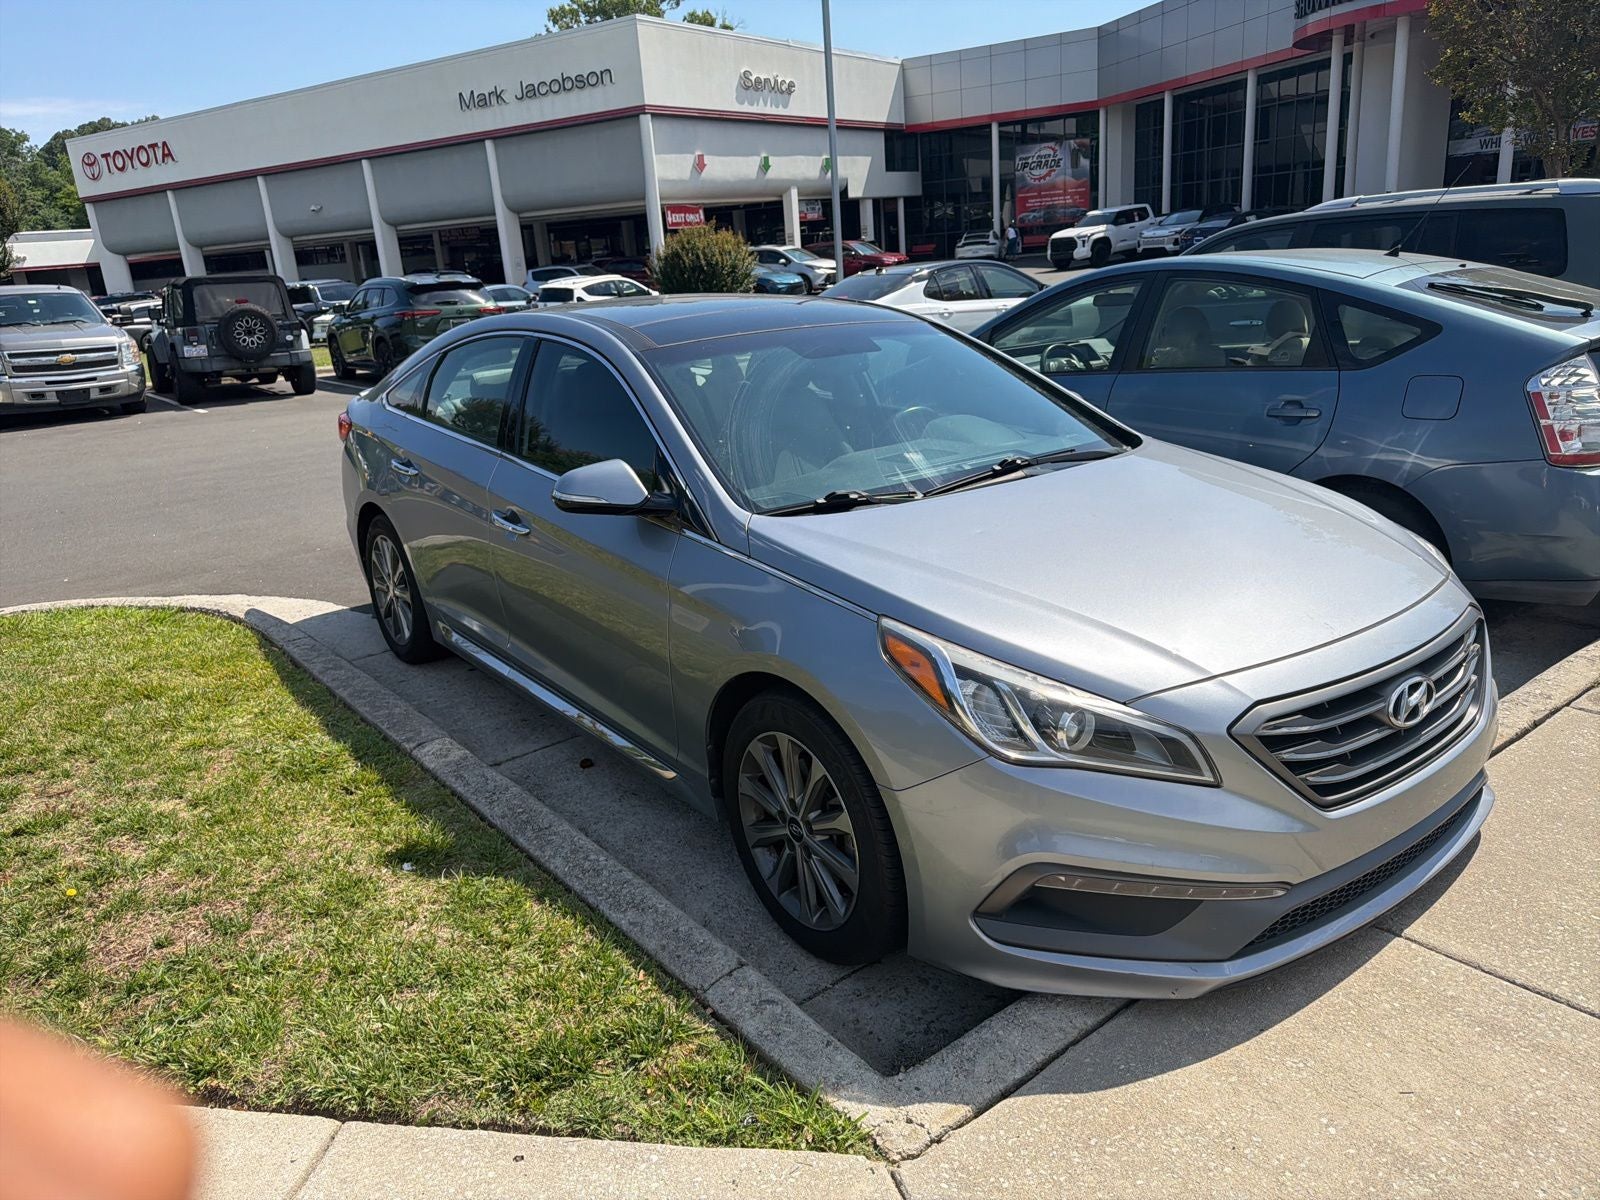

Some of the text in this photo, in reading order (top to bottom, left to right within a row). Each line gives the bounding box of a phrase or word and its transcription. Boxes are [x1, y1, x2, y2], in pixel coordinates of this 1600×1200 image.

[458, 68, 614, 111] Mark Jacobson
[741, 70, 796, 95] Service
[101, 141, 176, 174] TOYOTA
[1016, 158, 1063, 172] UPGRADE
